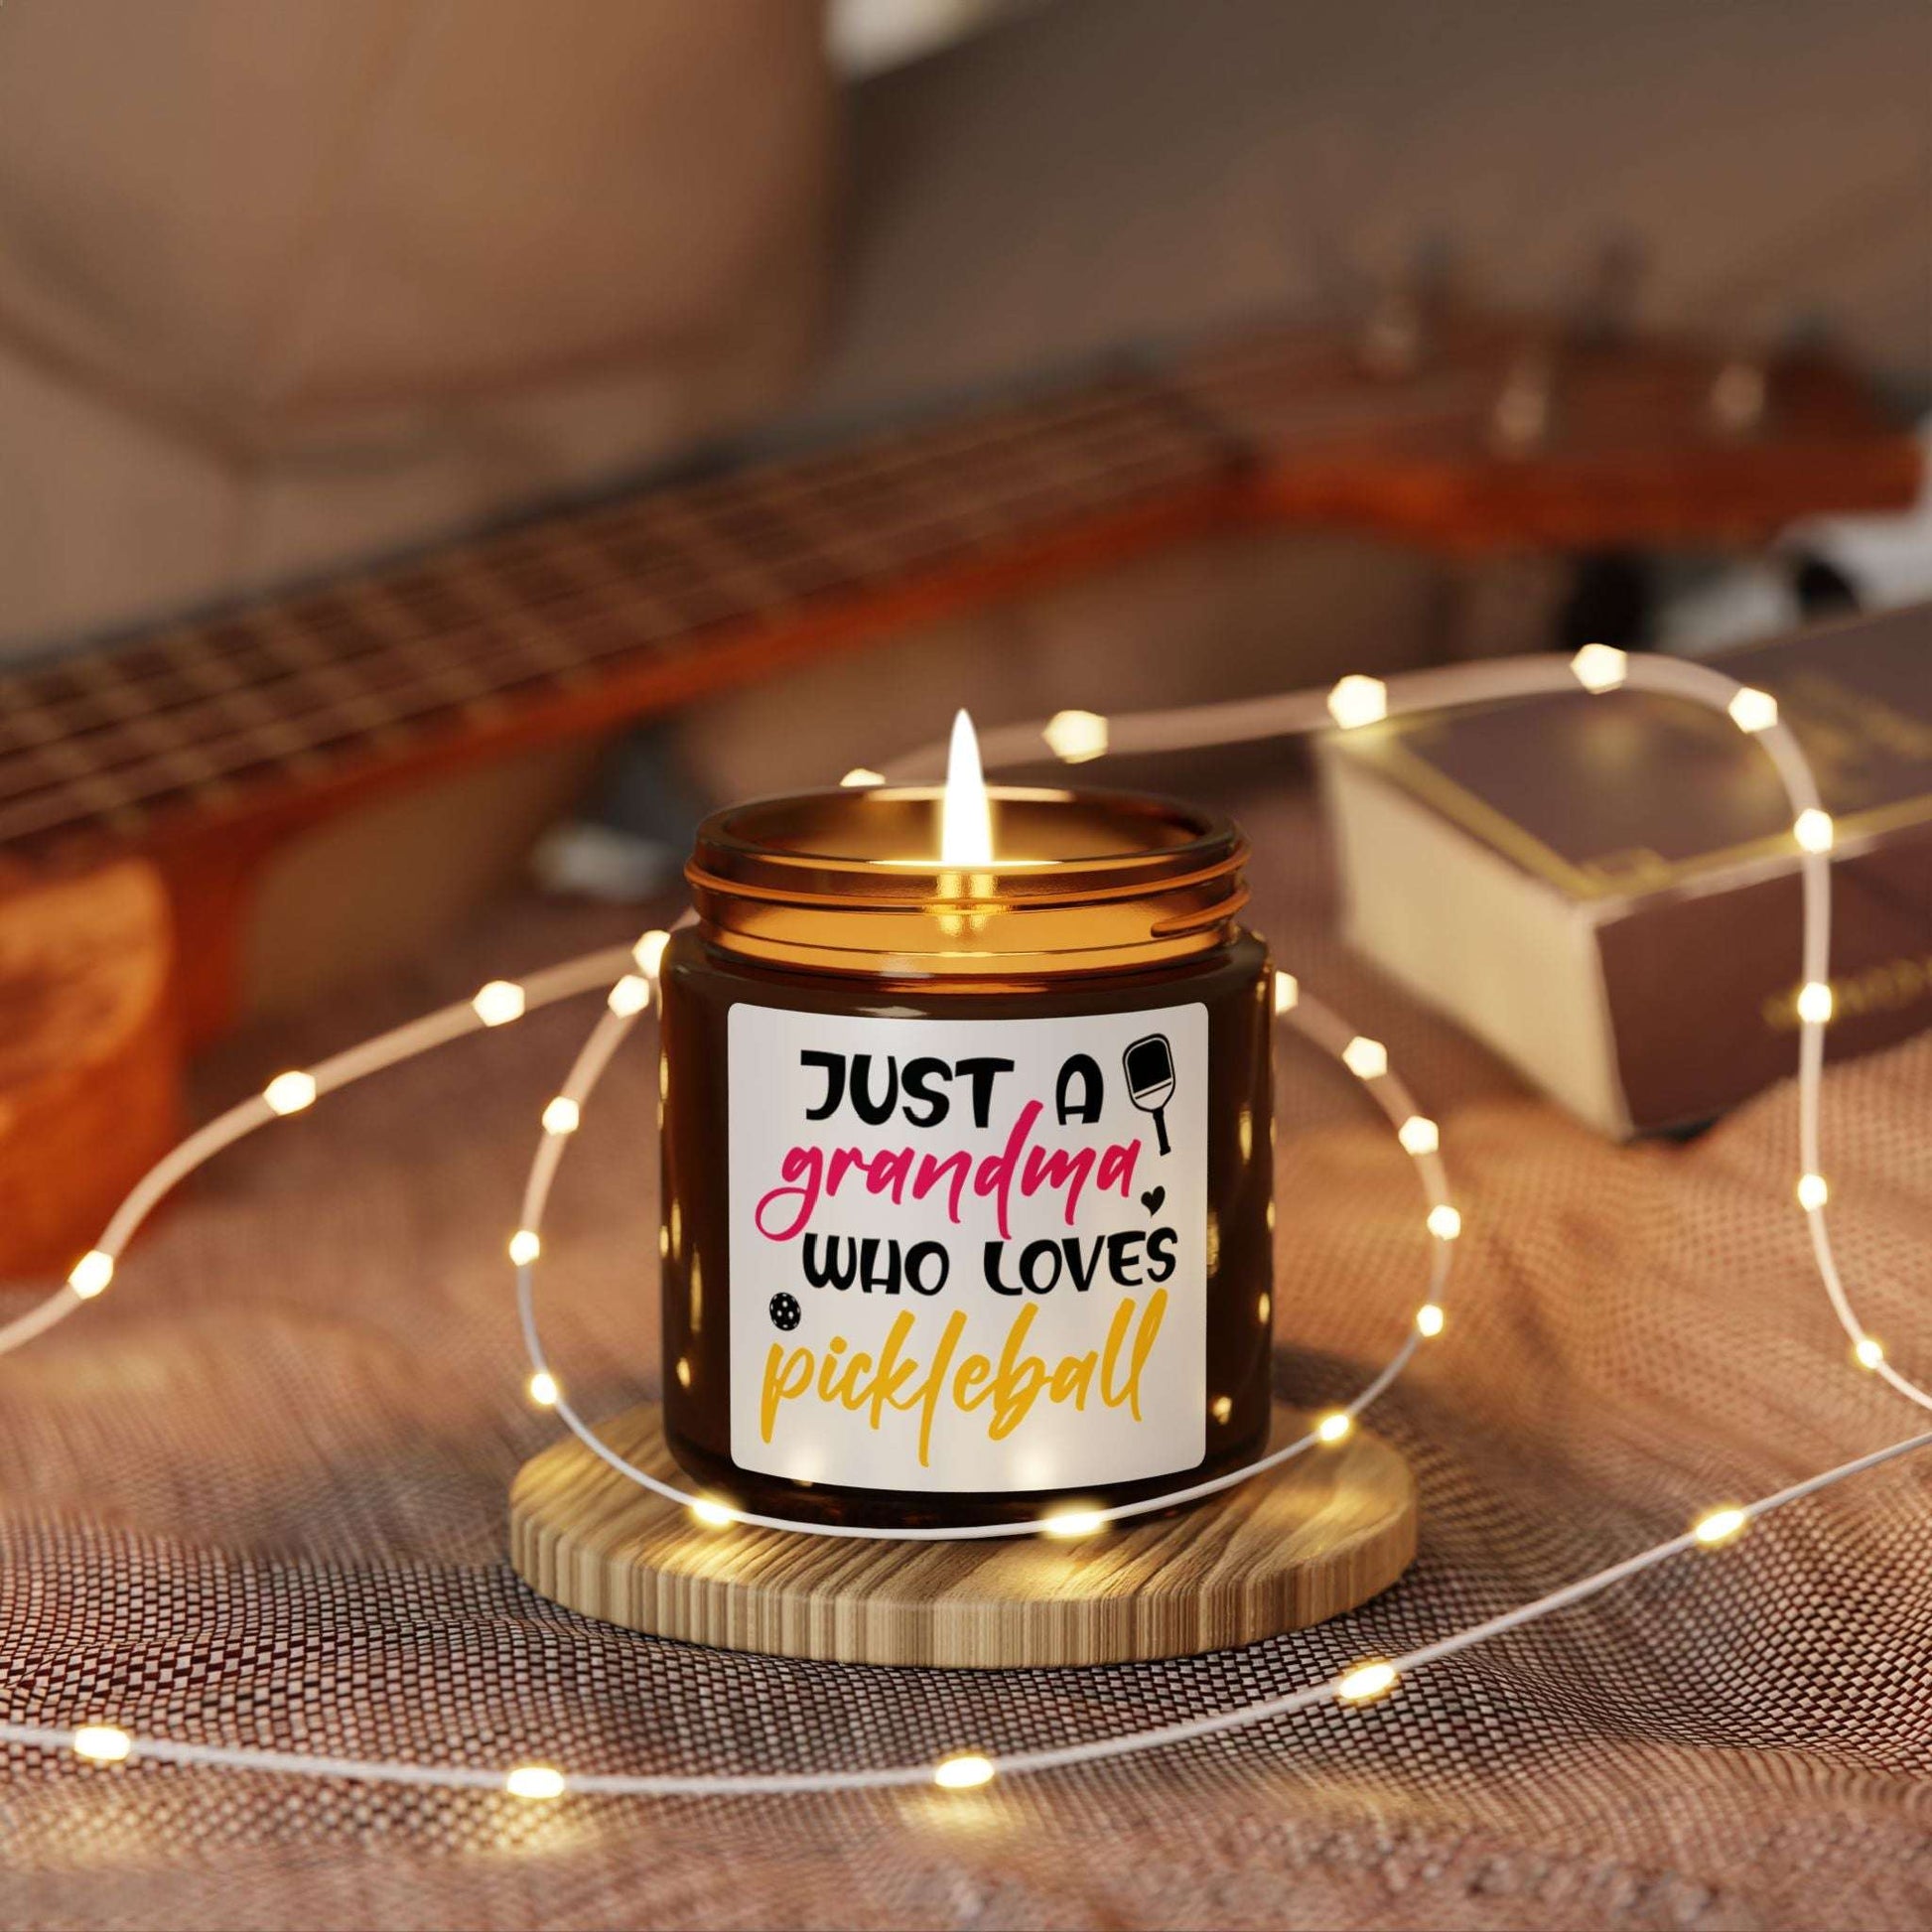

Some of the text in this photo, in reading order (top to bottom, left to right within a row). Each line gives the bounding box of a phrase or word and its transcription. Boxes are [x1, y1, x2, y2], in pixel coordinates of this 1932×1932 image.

[800, 1049, 1104, 1128] JUST A
[755, 1100, 1142, 1241] grandma
[802, 1227, 1178, 1296] WHO LOVES
[759, 1288, 1169, 1467] pickleball
